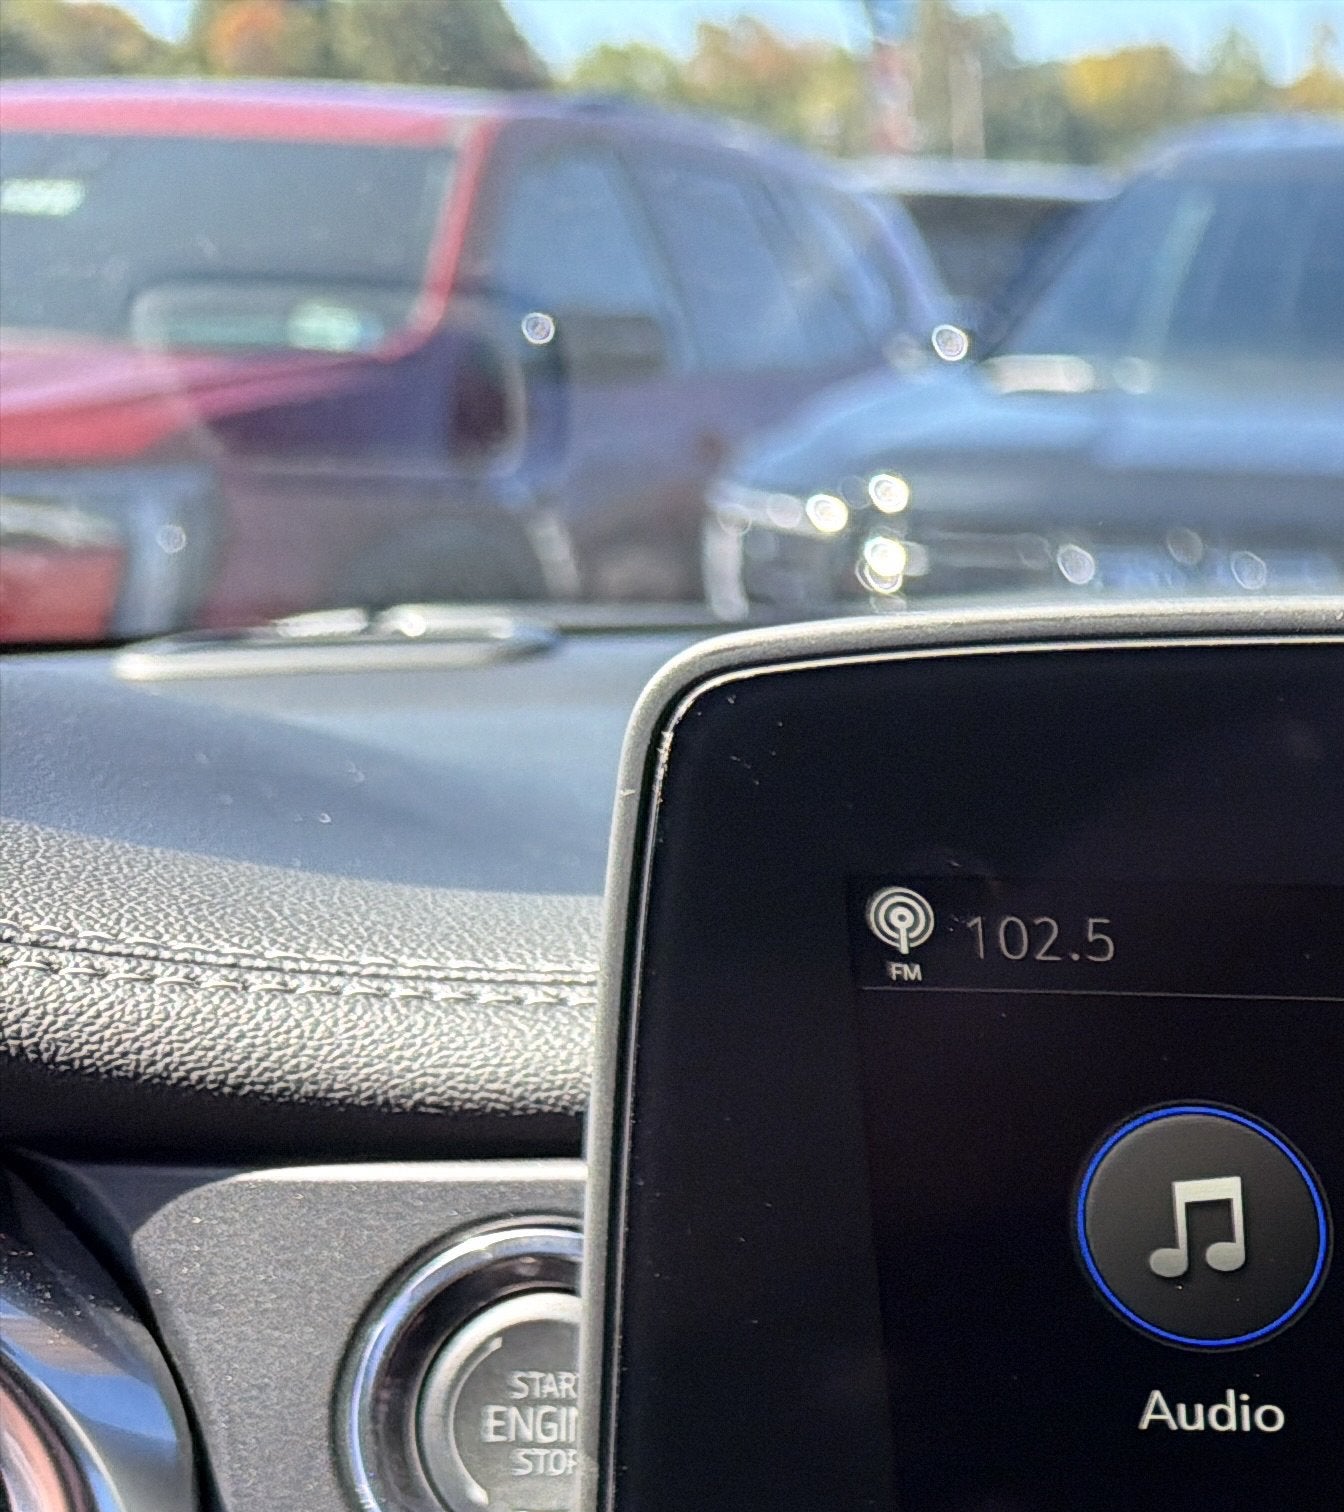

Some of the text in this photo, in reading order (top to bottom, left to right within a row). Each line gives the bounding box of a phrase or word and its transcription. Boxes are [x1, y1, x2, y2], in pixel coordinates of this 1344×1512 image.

[966, 915, 1115, 962] 102.5
[887, 961, 923, 981] FM
[506, 1371, 577, 1399] STAR
[480, 1405, 579, 1443] ENGI
[1138, 1388, 1285, 1433] Audio
